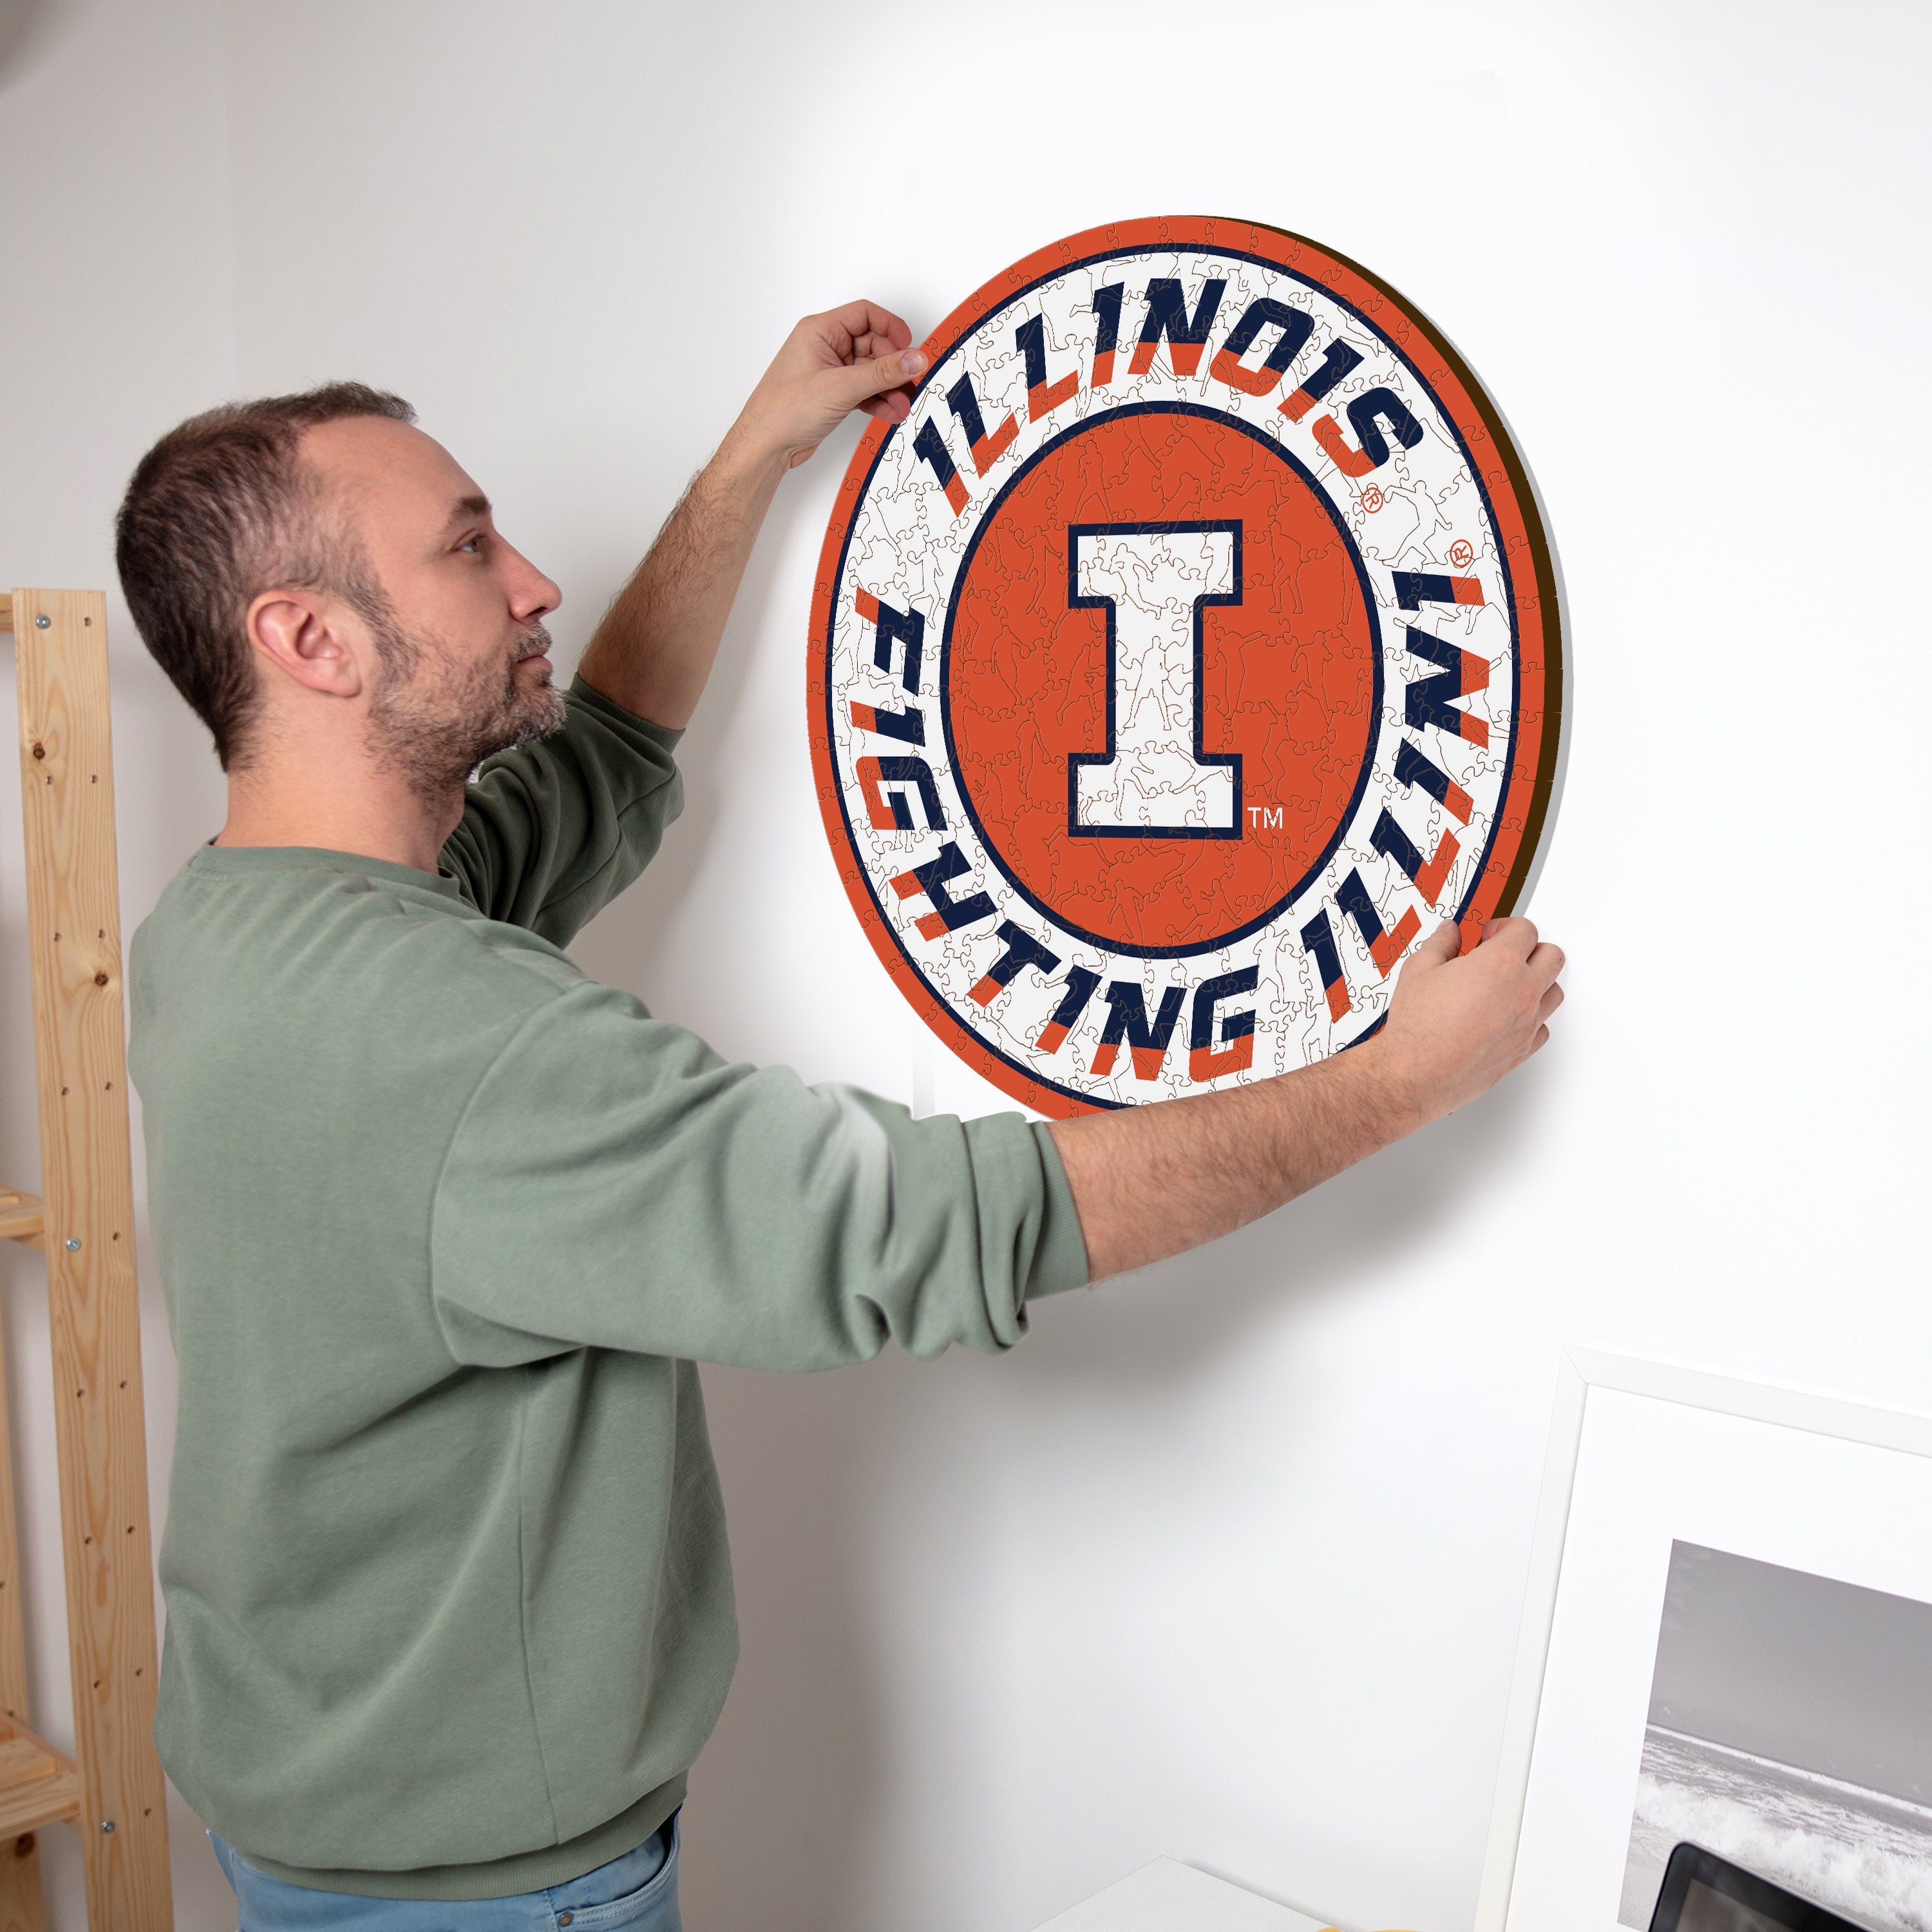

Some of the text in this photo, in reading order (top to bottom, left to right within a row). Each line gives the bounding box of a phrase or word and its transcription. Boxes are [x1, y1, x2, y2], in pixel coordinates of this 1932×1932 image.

[913, 278, 1425, 518] ILLINOIS
[1068, 519, 1242, 840] I
[1247, 807, 1283, 829] TM
[850, 570, 1490, 1083] FIGHTING ILLINI
